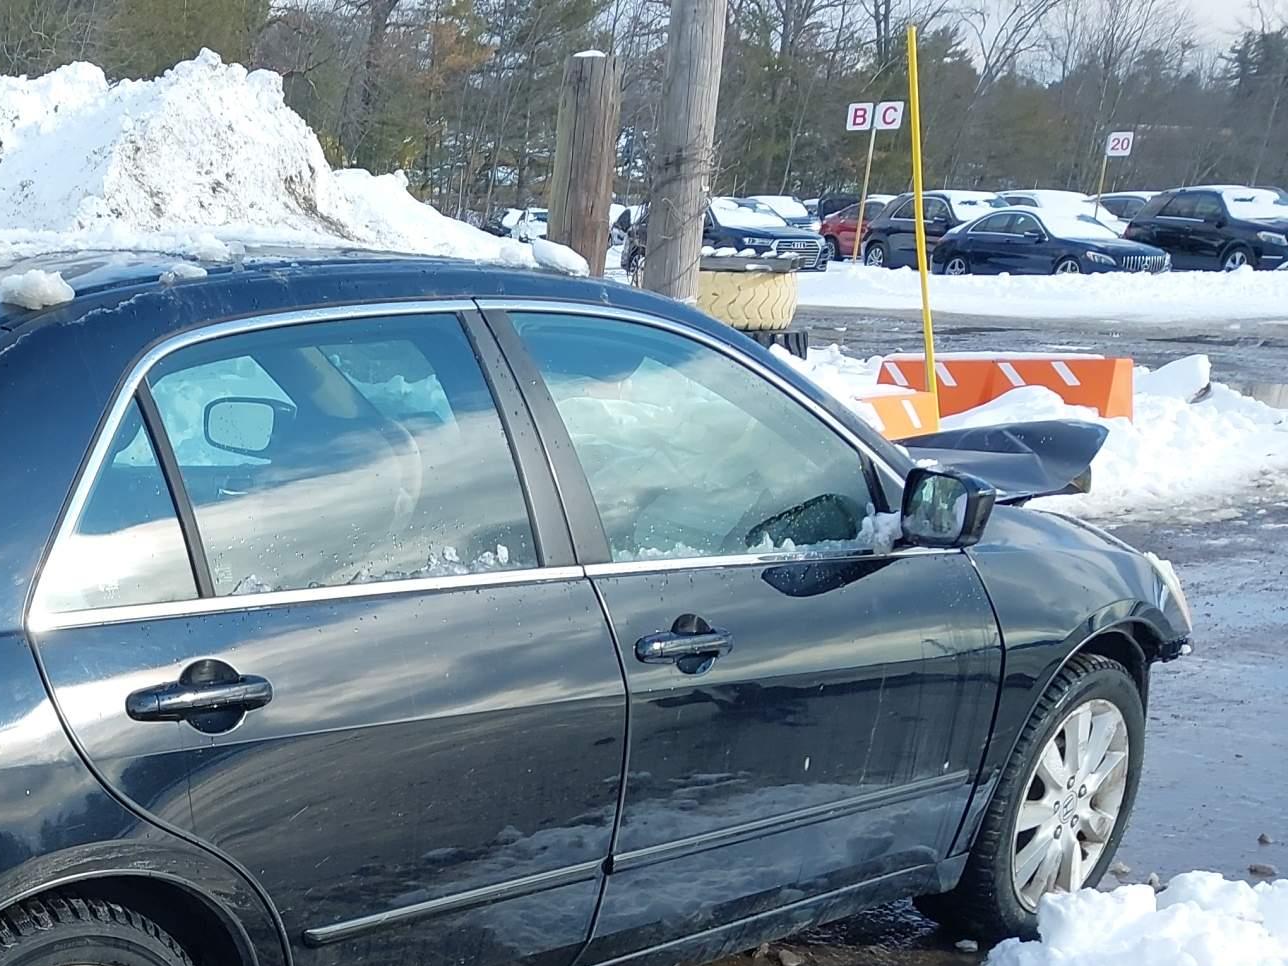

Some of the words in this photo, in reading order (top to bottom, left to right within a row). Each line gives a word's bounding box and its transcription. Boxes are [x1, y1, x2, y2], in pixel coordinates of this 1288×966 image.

[852, 107, 868, 126] B
[881, 105, 899, 125] C
[1110, 137, 1131, 152] 20
